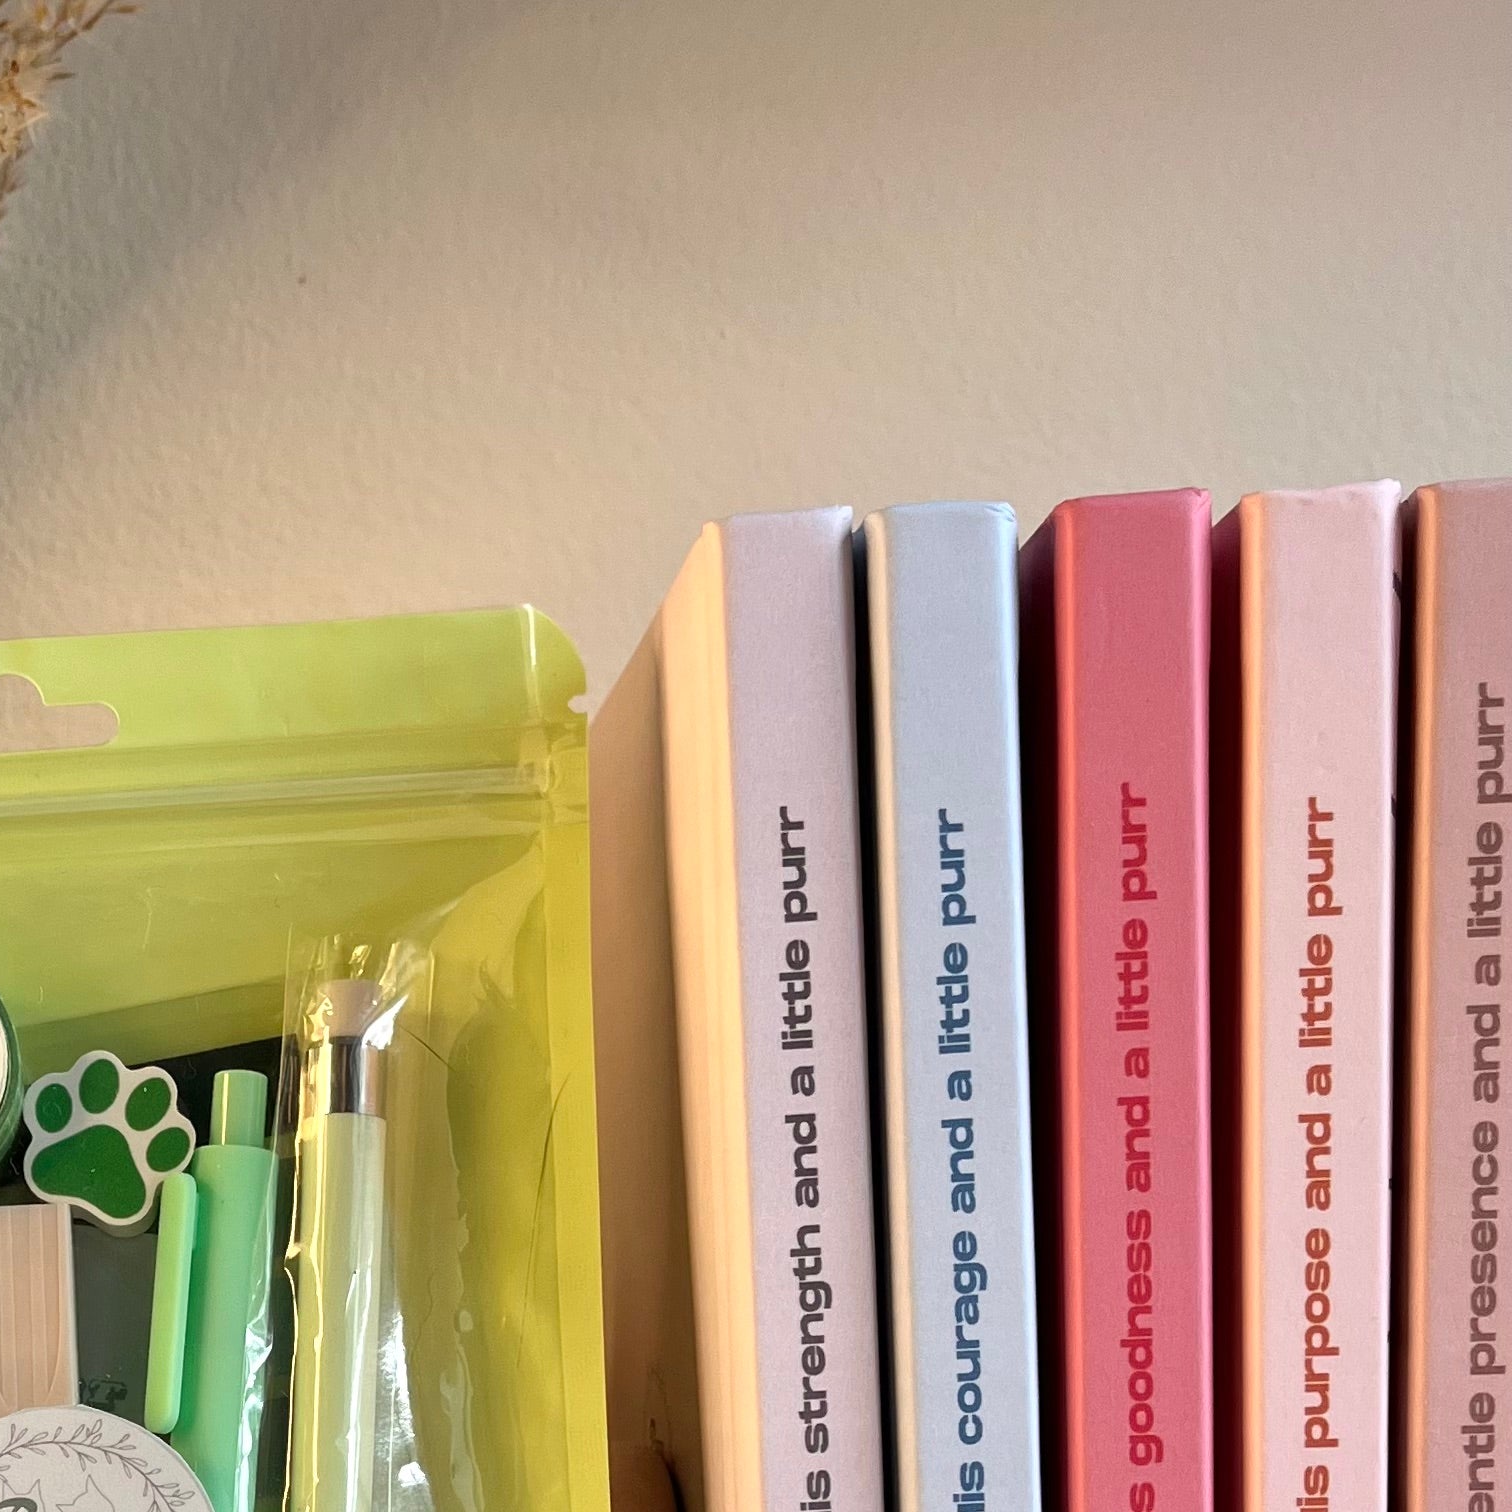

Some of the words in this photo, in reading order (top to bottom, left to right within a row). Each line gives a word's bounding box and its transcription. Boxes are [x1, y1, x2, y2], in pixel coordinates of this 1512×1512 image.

[1477, 682, 1512, 804] purr
[780, 806, 817, 923] purr
[938, 808, 976, 926] purr
[1121, 782, 1157, 902] purr
[1307, 797, 1343, 917] purr
[1467, 822, 1503, 938] little
[779, 939, 813, 1050] little
[936, 943, 971, 1054] little
[1115, 918, 1149, 1031] little
[1299, 934, 1333, 1048] little
[1475, 954, 1501, 986] a
[791, 1066, 815, 1096] a
[947, 1070, 972, 1101] a
[1124, 1047, 1150, 1079] a
[1306, 1064, 1332, 1096] a
[1466, 1004, 1500, 1103] and
[785, 1113, 819, 1208] and
[941, 1118, 976, 1214] and
[1117, 1096, 1151, 1193] and
[1298, 1113, 1331, 1211] and
[1470, 1121, 1506, 1375] presence
[790, 1224, 832, 1453] strength
[952, 1231, 987, 1445] courage
[1120, 1209, 1164, 1466] goodness
[1304, 1228, 1339, 1448] purpose
